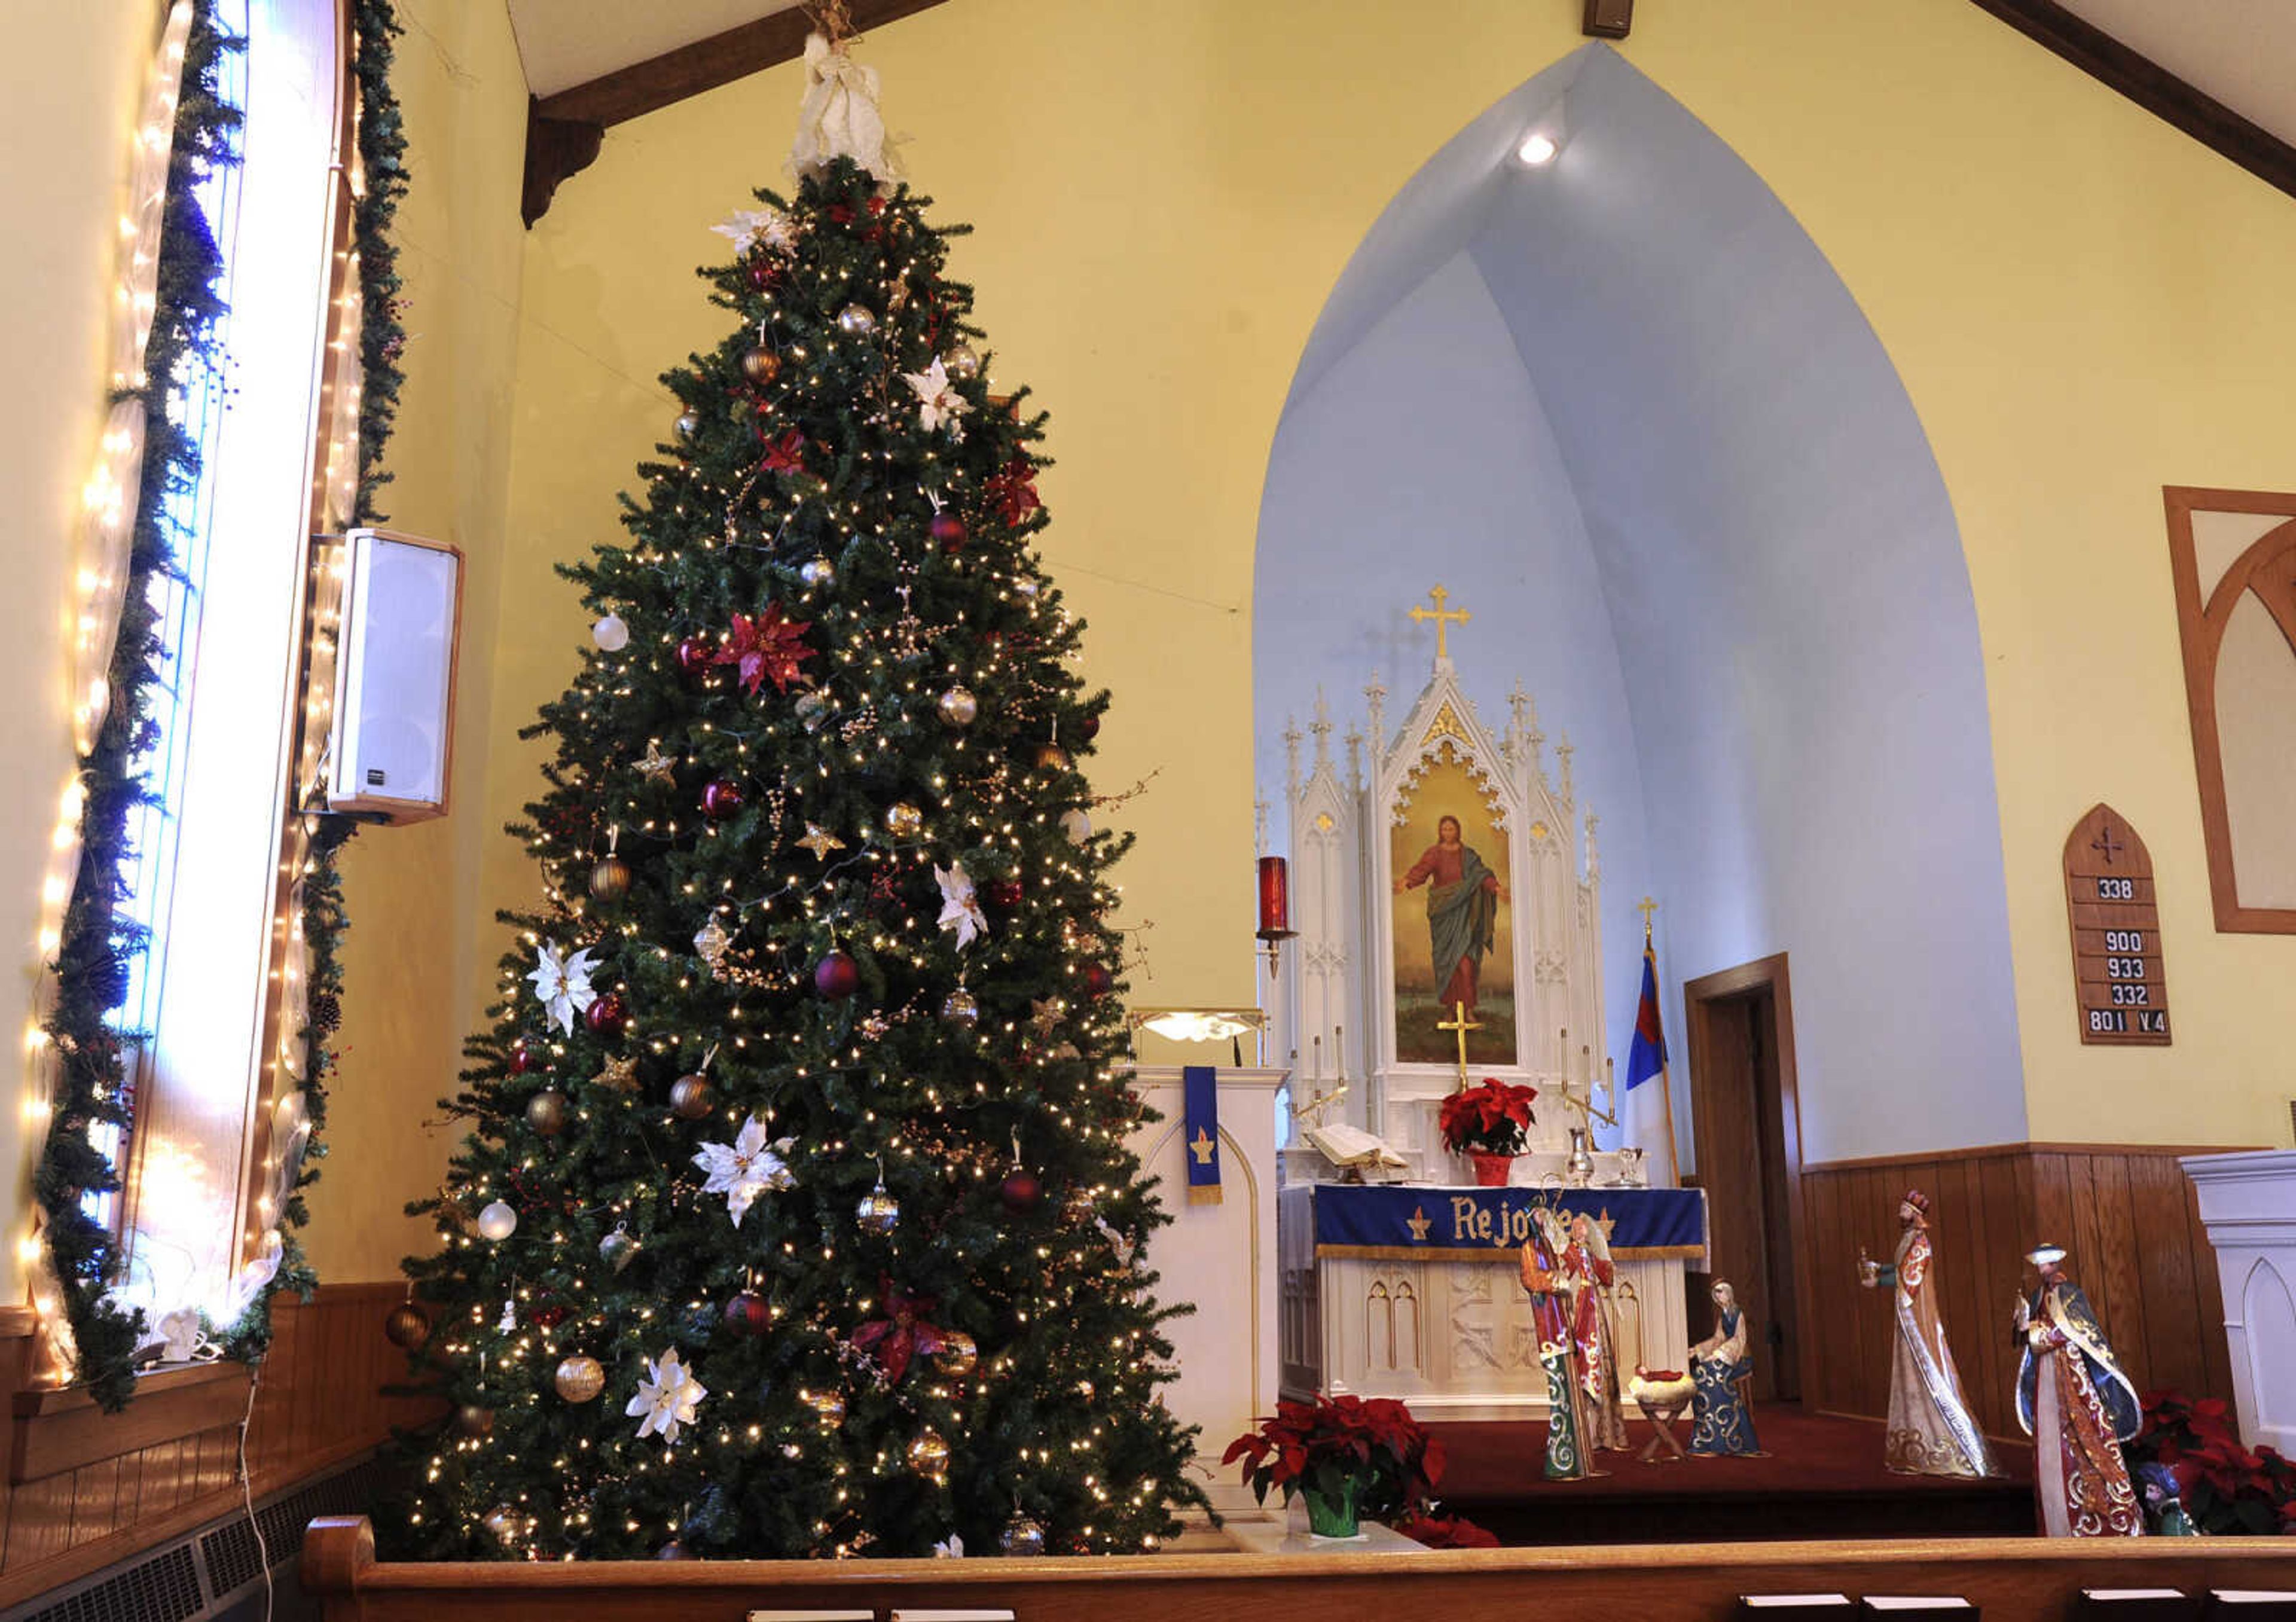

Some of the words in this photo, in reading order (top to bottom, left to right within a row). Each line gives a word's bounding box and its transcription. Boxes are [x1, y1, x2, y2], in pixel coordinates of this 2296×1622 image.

[2099, 879, 2132, 898] 338
[2106, 931, 2142, 952] 900
[2108, 958, 2144, 978] 933
[2112, 985, 2148, 1005] 332
[2090, 1011, 2123, 1031] 801
[1450, 1196, 1573, 1248] Rejoe
